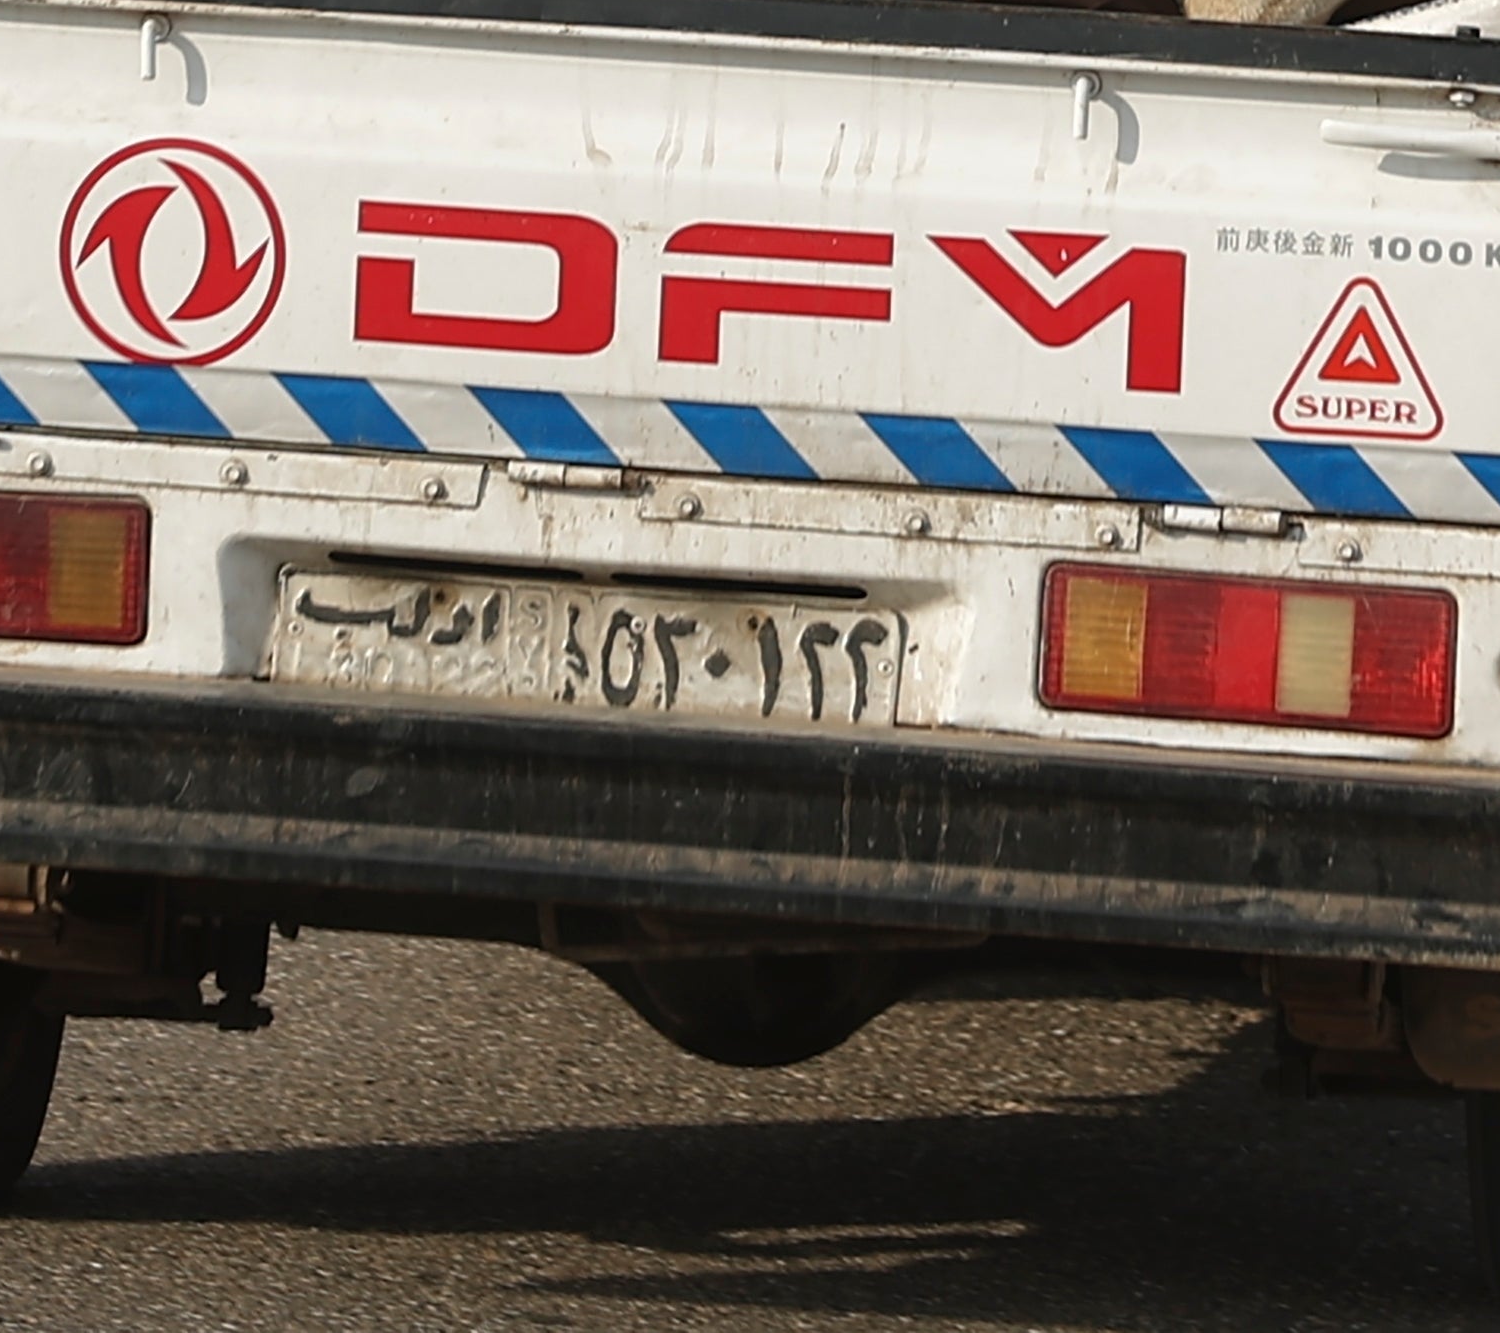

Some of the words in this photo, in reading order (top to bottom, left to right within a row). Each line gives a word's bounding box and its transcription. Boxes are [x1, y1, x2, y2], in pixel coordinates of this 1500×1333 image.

[1368, 235, 1473, 266] 1000
[353, 199, 1188, 395] DFM
[1294, 394, 1418, 425] SUPER
